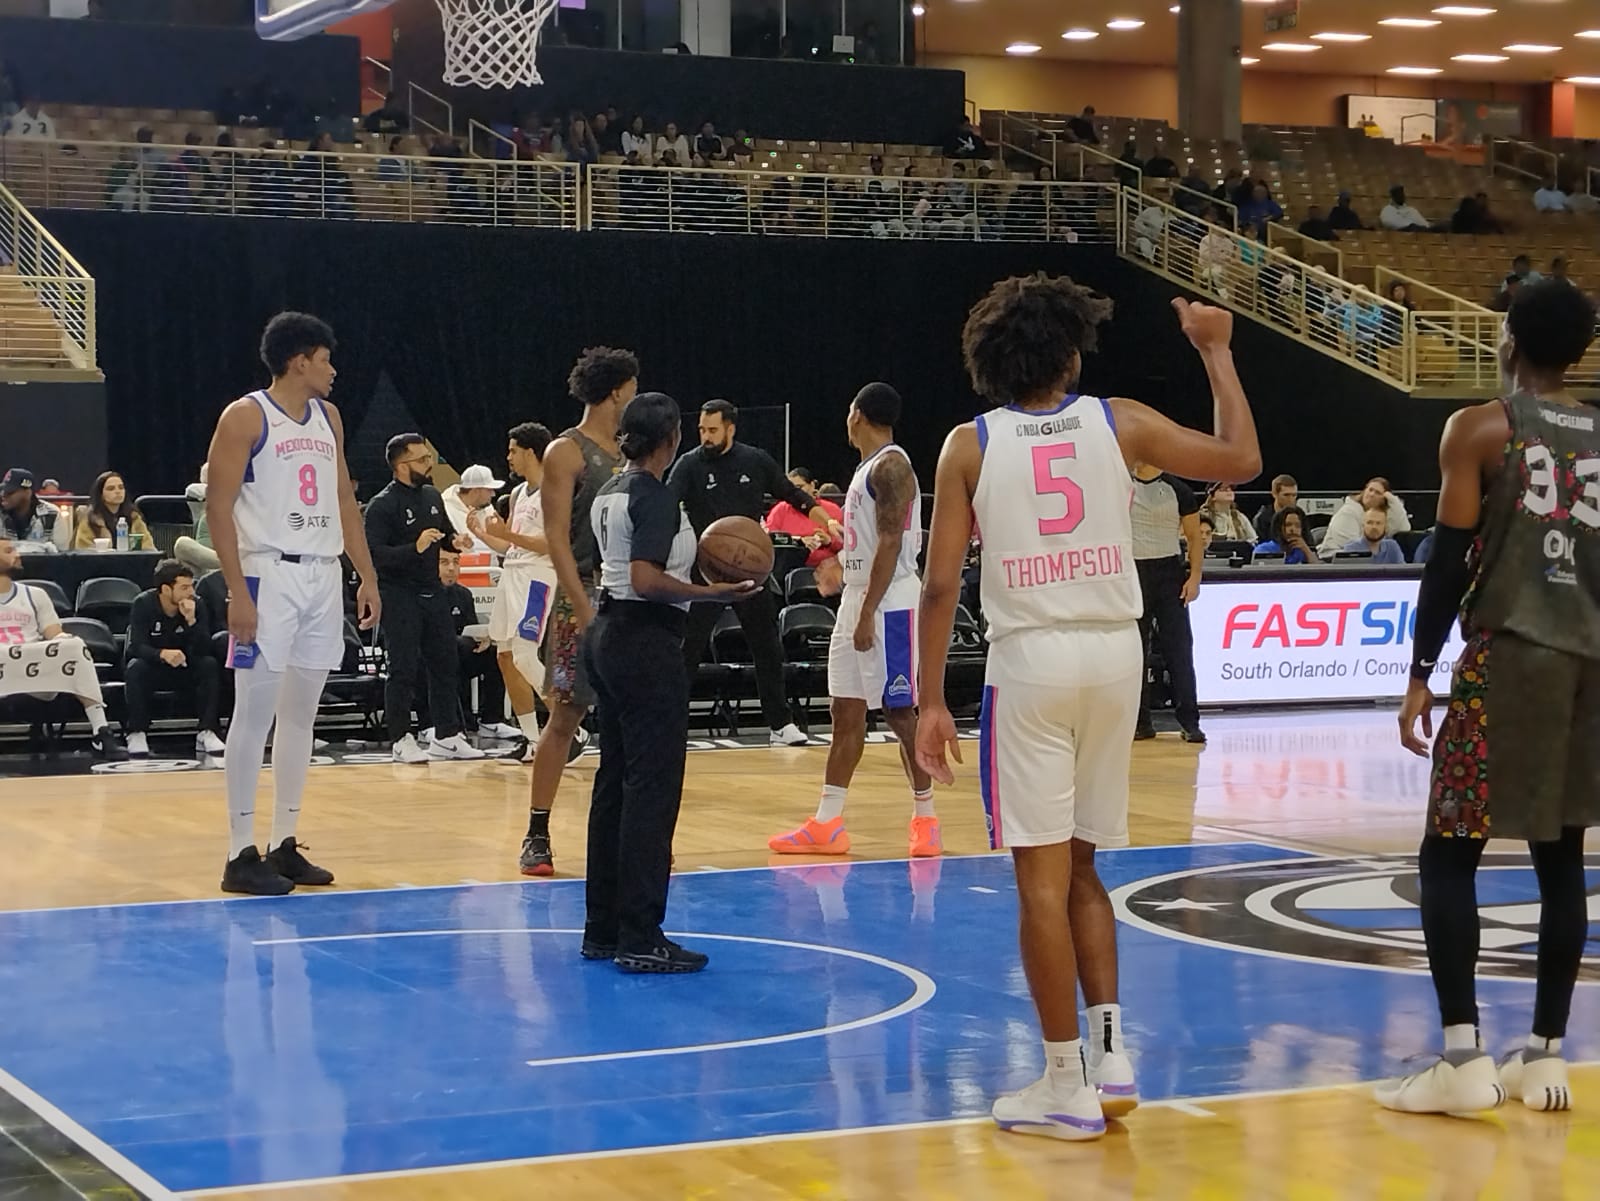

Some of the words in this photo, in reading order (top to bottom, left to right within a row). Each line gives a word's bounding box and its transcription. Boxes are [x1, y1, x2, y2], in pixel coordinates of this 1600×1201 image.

[275, 438, 313, 457] MEXICO
[298, 463, 318, 506] 8
[1031, 442, 1085, 536] 5
[1002, 545, 1123, 588] THOMPSON
[1222, 601, 1449, 649] FASTSI
[1221, 660, 1272, 680] South
[1278, 659, 1347, 678] Orlando
[1365, 657, 1455, 676] Convio
